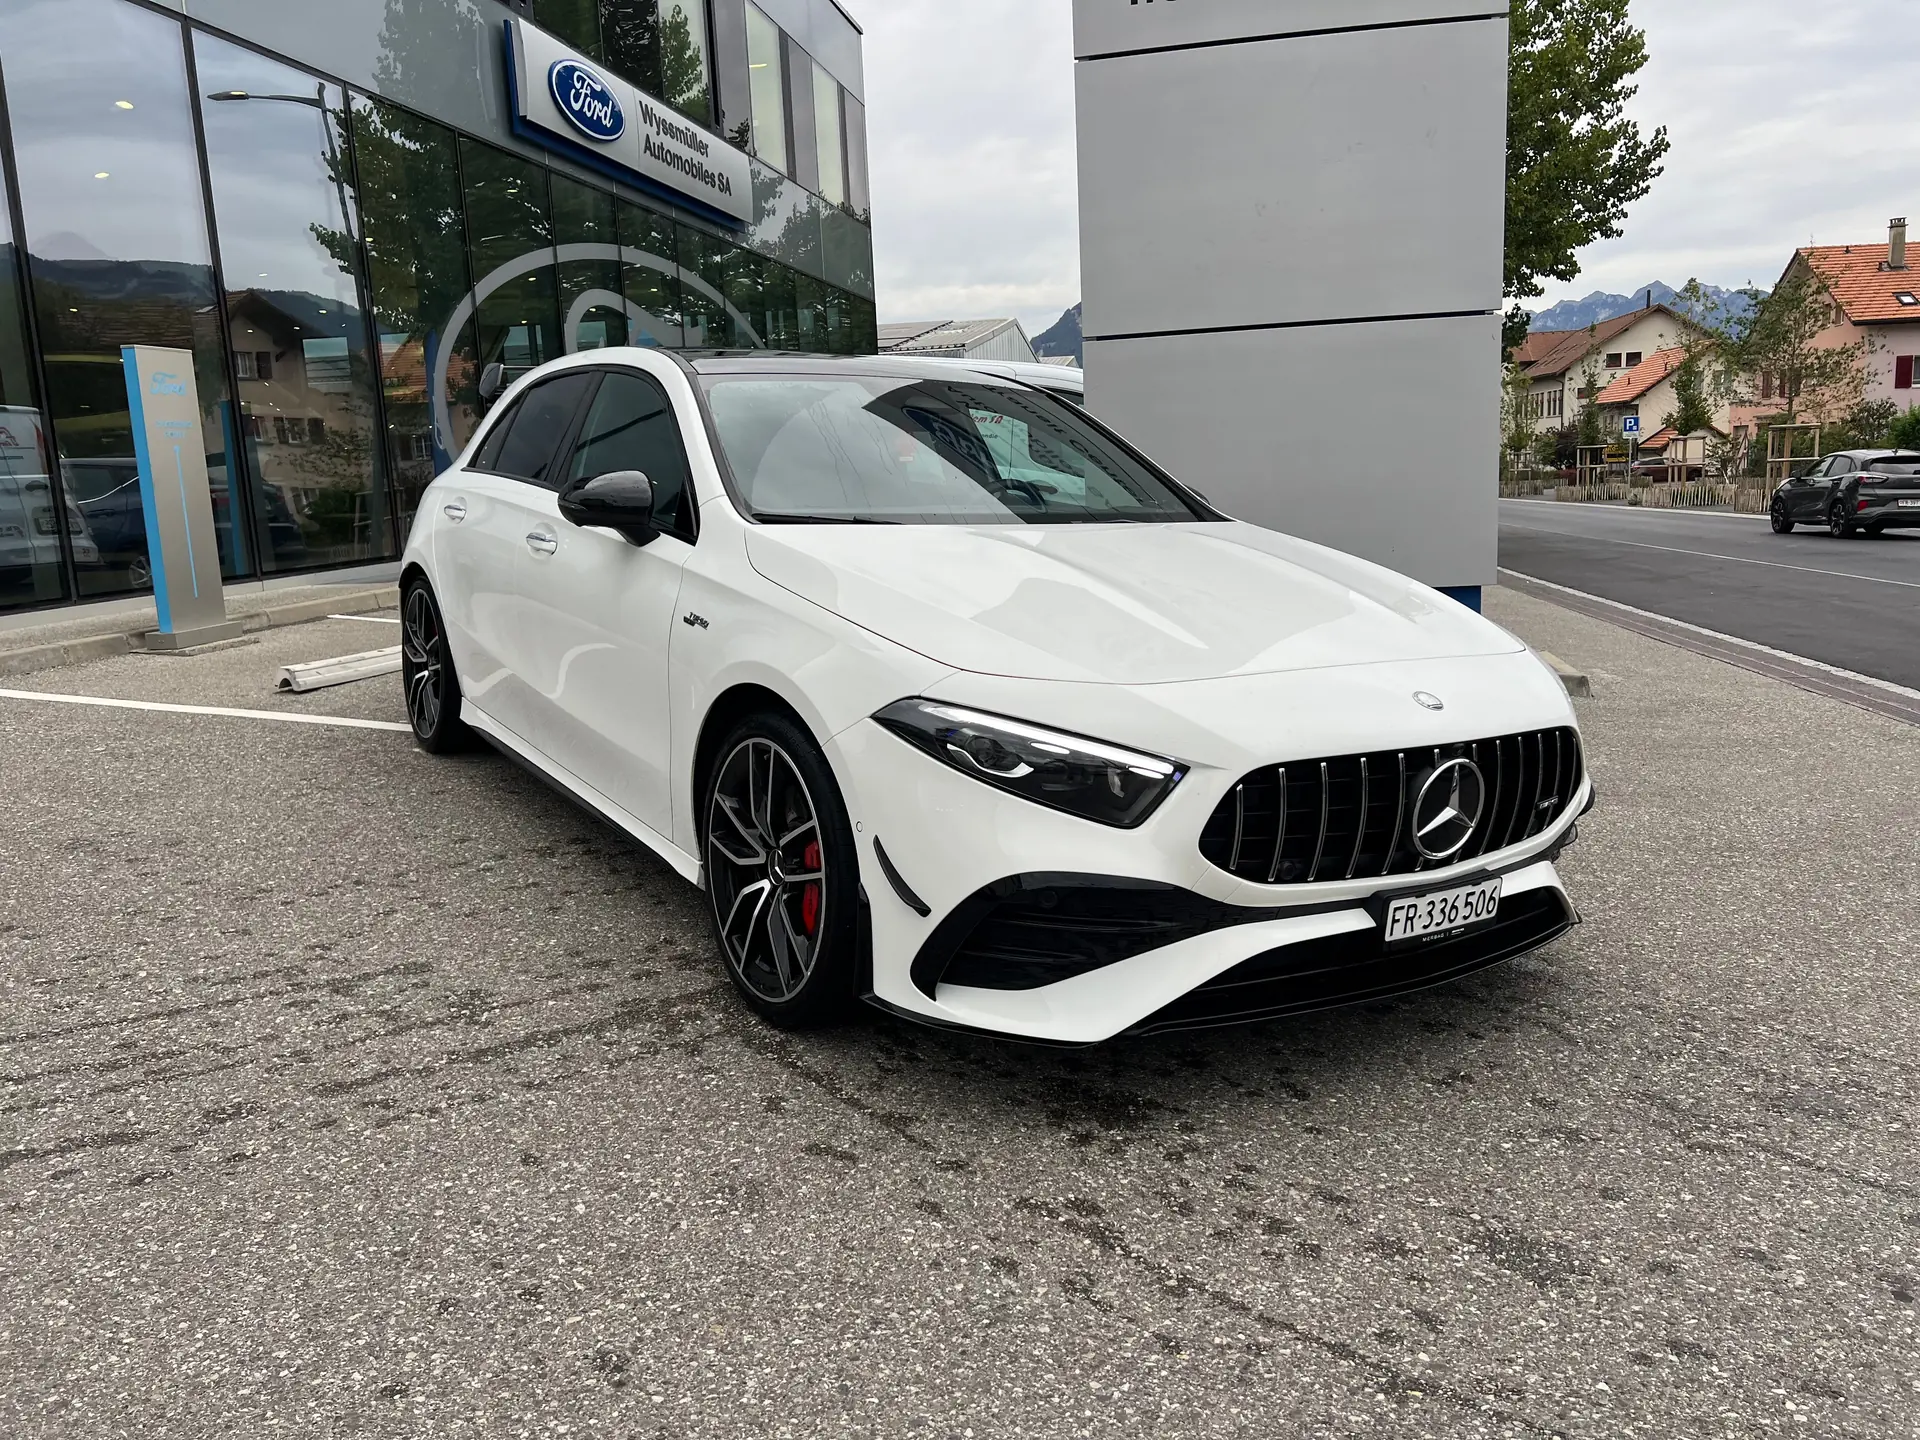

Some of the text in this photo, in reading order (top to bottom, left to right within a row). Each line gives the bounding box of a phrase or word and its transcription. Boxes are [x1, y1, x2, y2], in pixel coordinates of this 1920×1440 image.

[569, 70, 614, 129] Ford
[639, 100, 709, 158] Wyssmüller
[643, 133, 732, 197] Automobiles SA
[150, 371, 186, 396] Ford
[1626, 418, 1635, 430] P
